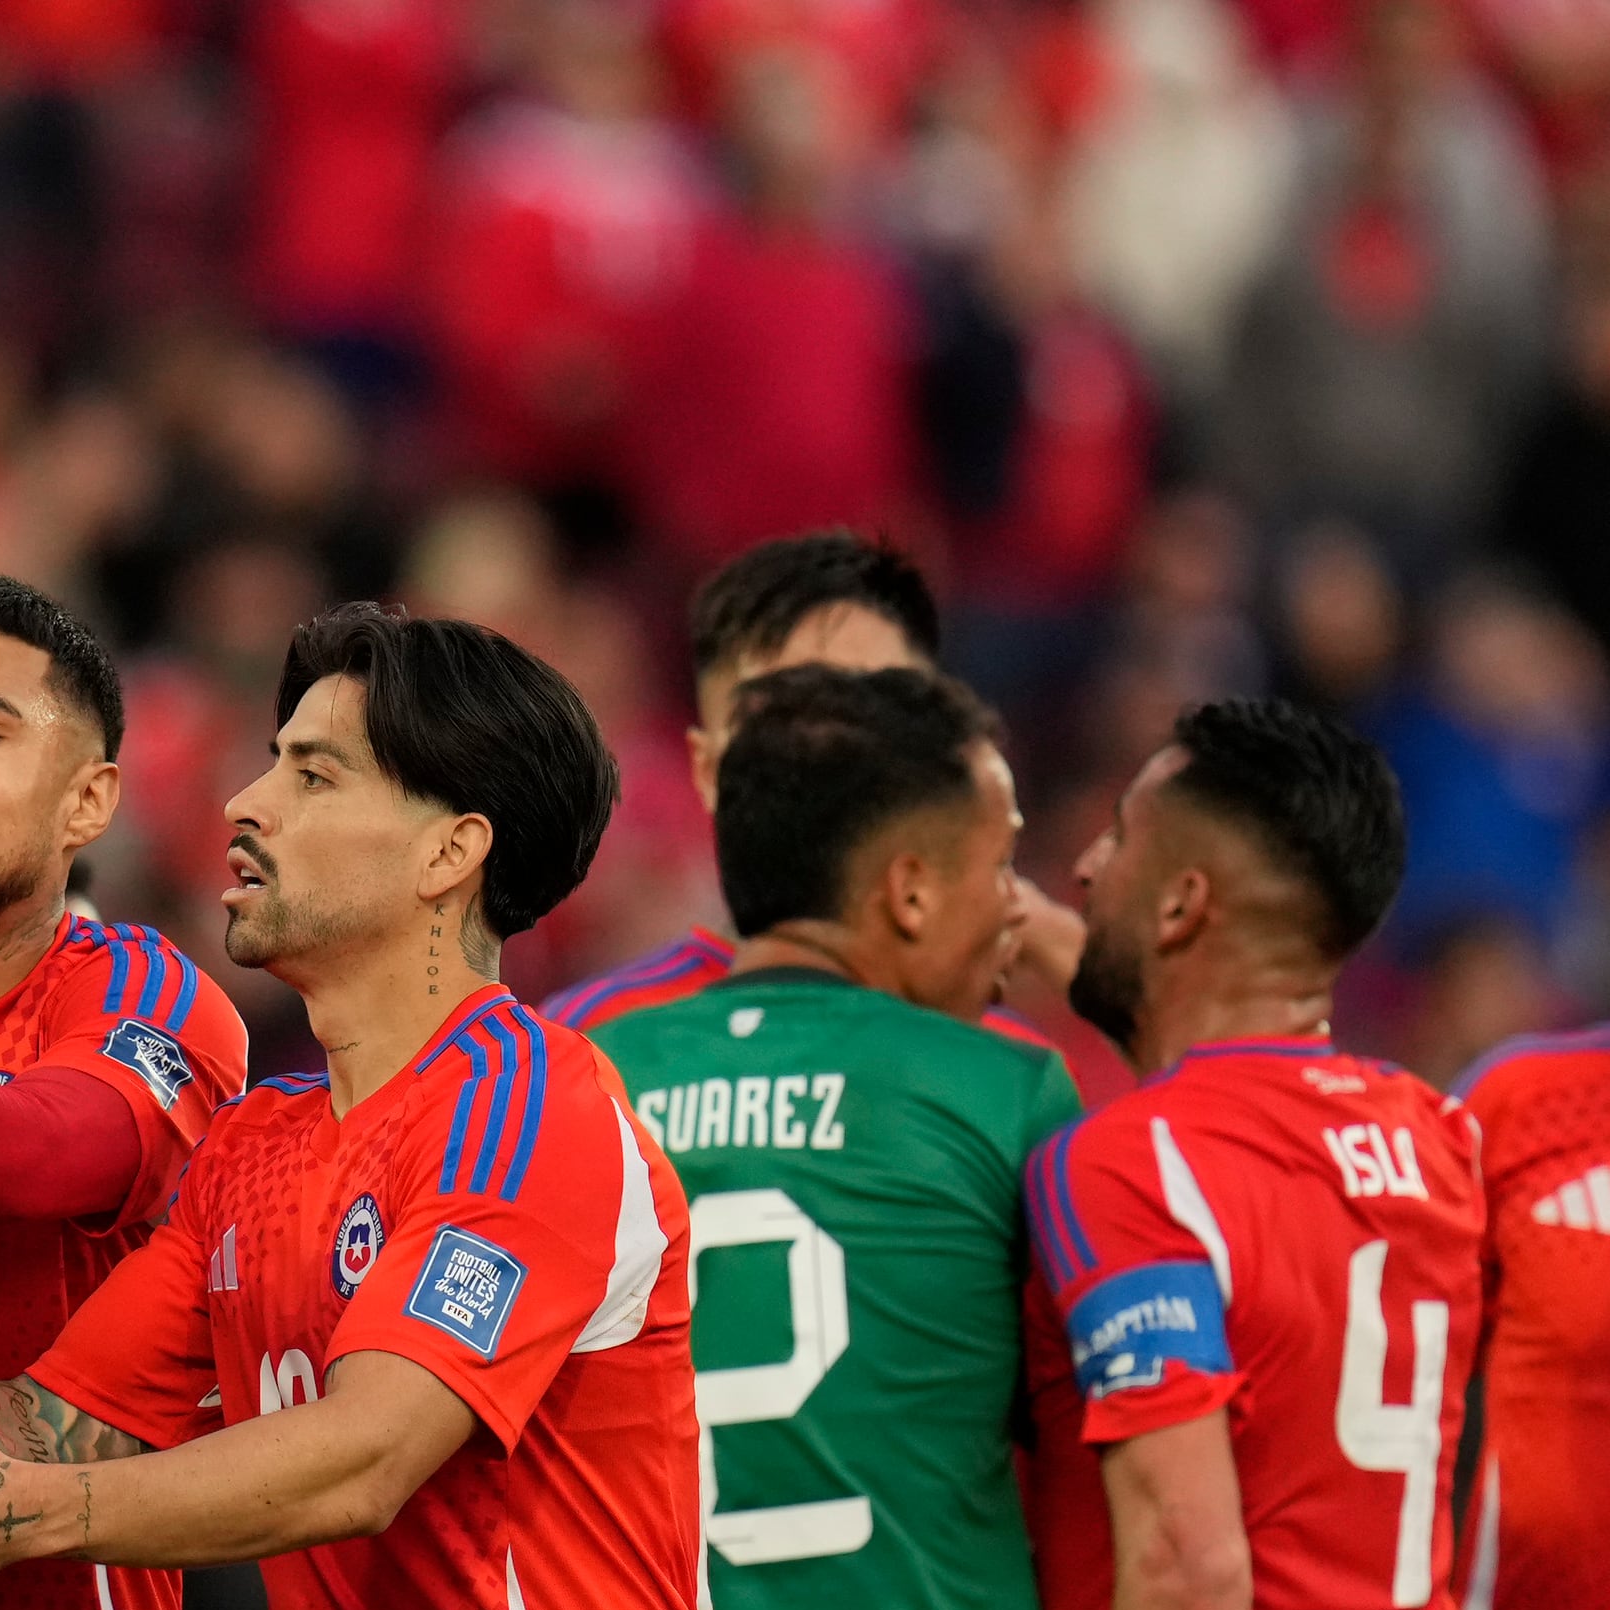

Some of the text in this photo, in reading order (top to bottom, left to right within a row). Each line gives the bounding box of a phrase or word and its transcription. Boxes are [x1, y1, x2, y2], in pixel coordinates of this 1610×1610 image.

[637, 1073, 846, 1150] SUAREZ
[444, 1263, 498, 1303] UNITES
[451, 1248, 502, 1286] FOOTBALL
[434, 1277, 495, 1321] the World
[447, 1304, 468, 1322] FIFA
[689, 1187, 873, 1566] 2
[1335, 1239, 1449, 1609] 4
